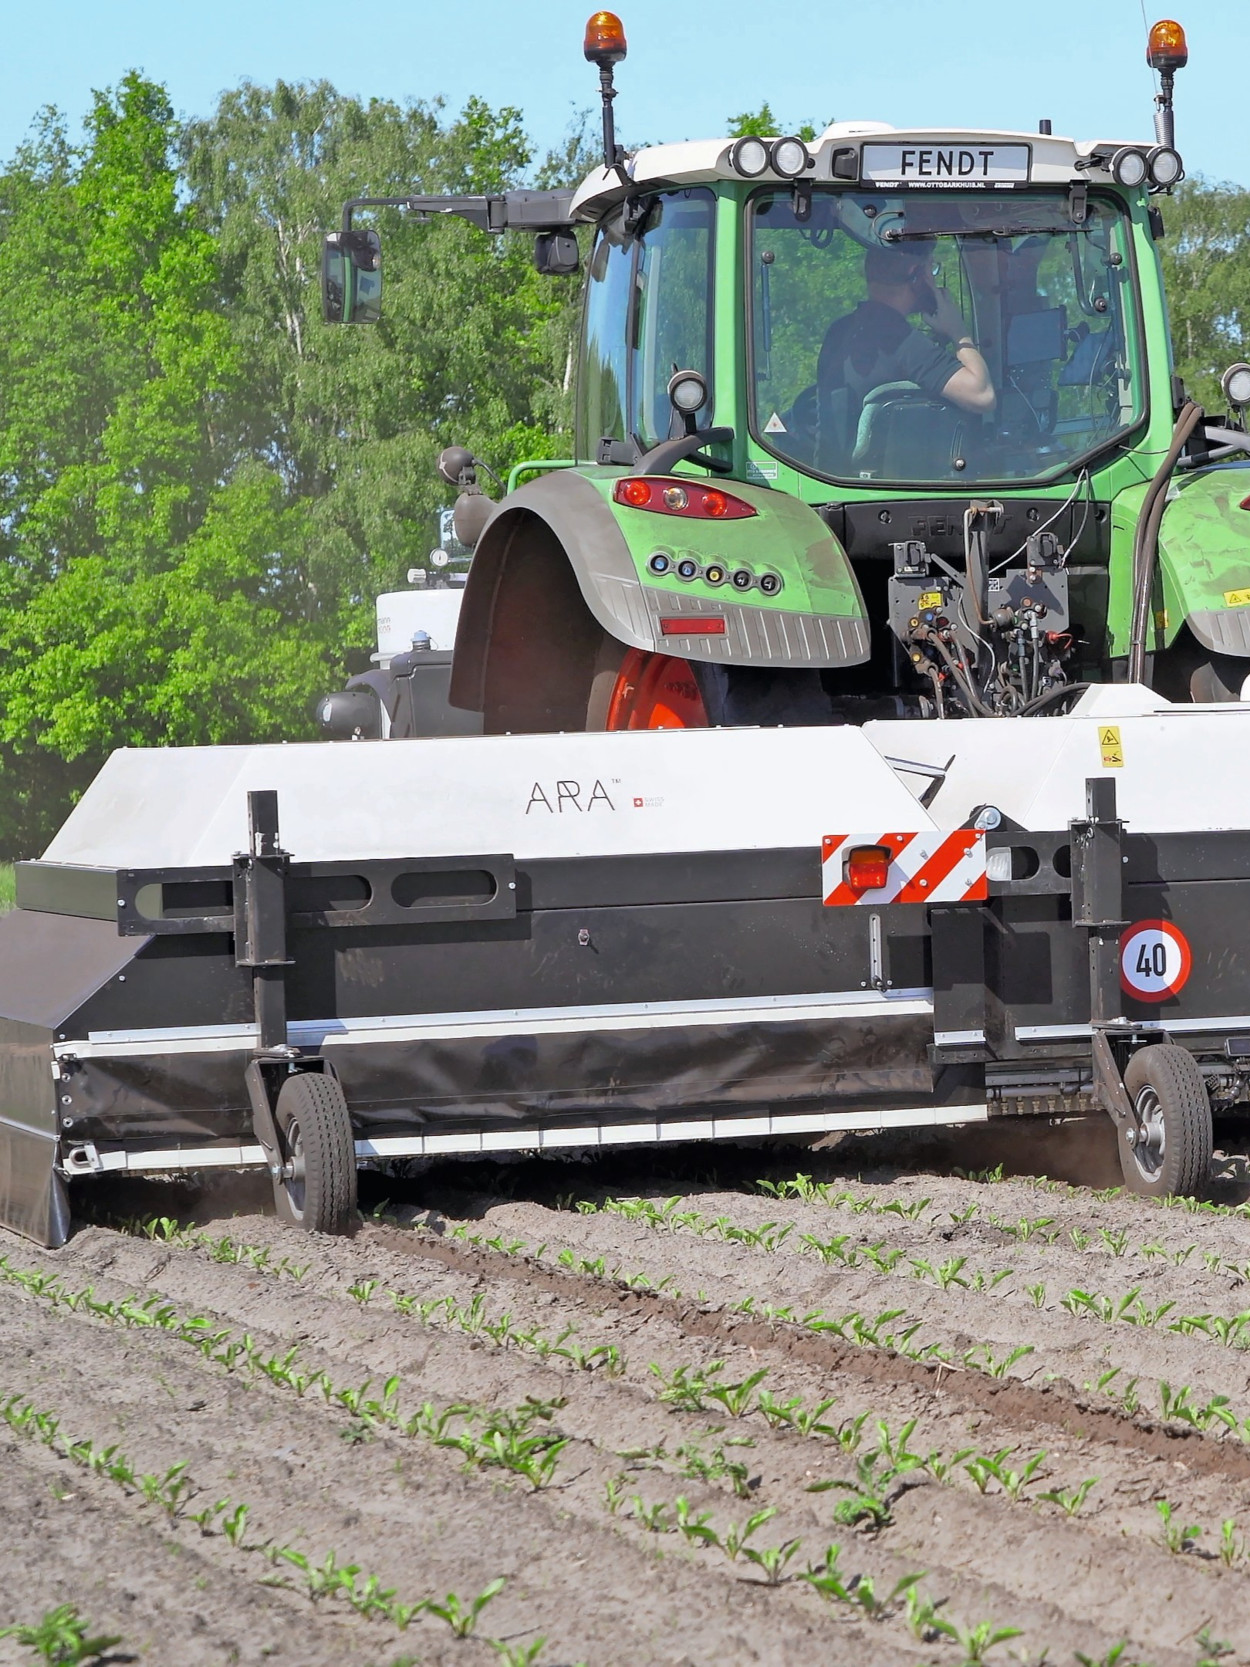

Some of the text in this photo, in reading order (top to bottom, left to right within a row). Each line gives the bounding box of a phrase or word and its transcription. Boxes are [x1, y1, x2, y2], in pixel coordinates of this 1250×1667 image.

[901, 150, 995, 176] FENDT
[525, 779, 616, 815] ARA
[1136, 942, 1167, 978] 40
